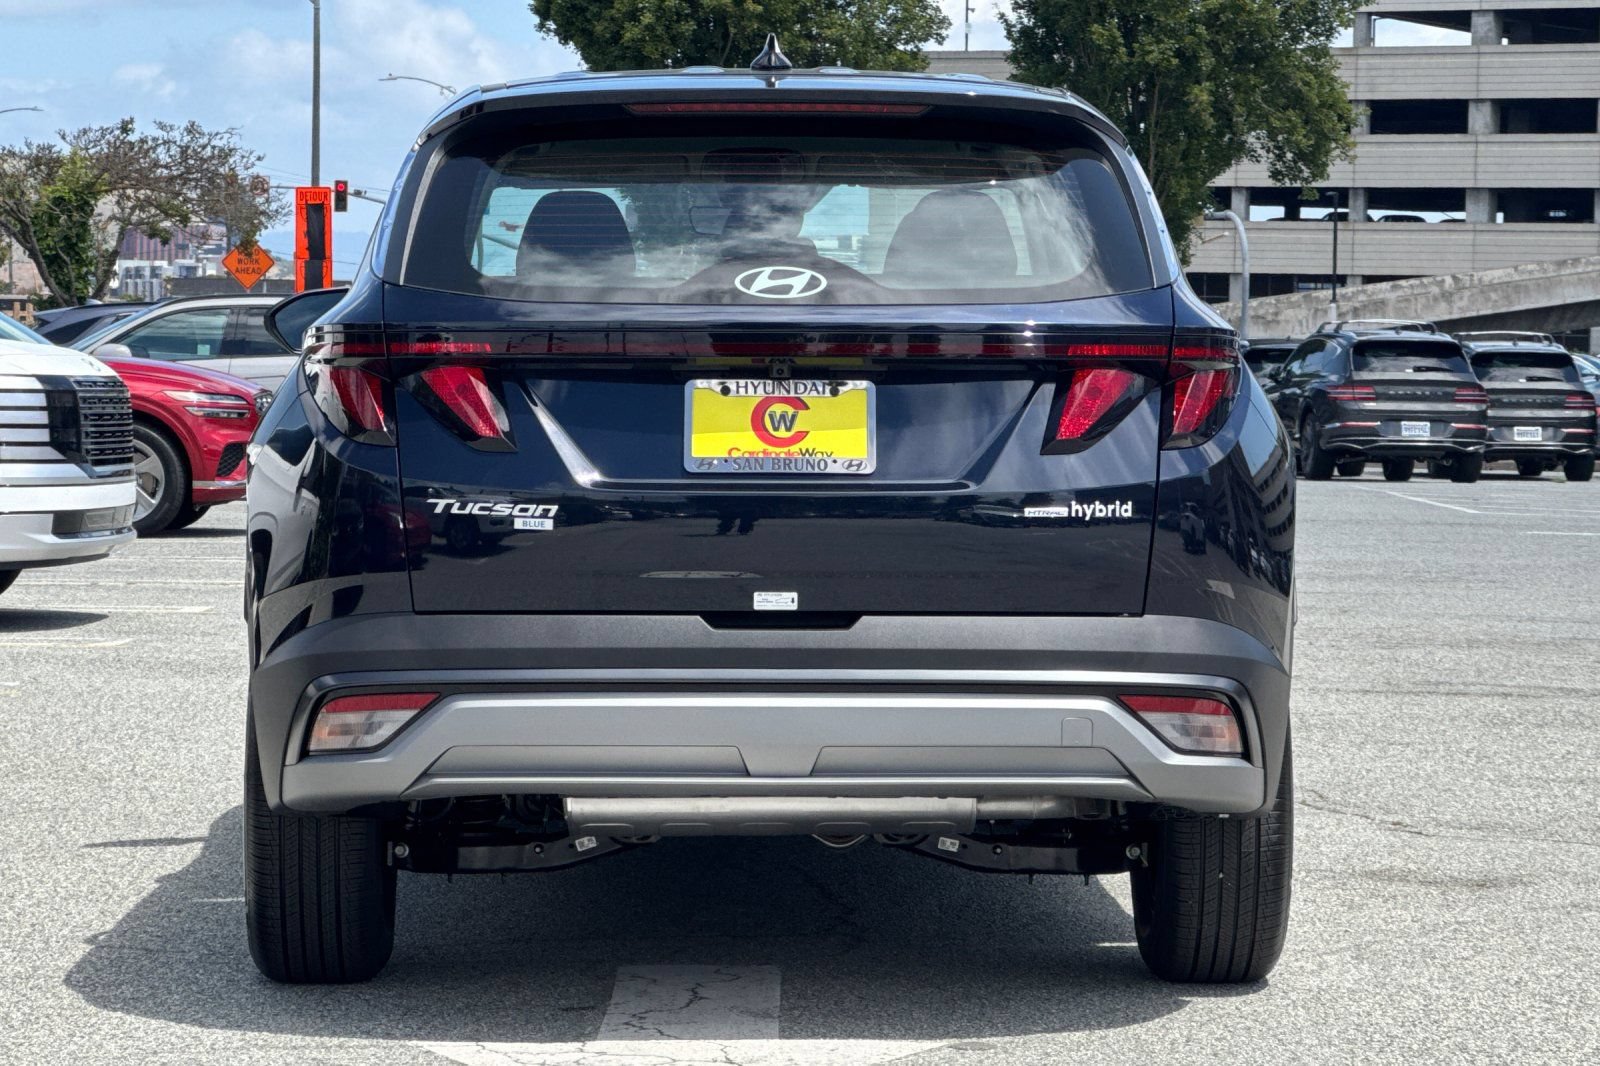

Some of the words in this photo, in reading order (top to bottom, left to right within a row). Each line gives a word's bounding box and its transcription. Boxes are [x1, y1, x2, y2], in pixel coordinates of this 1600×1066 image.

[300, 191, 328, 201] DETOUR
[735, 381, 826, 395] HYUNDAI
[732, 458, 765, 472] SAN
[771, 458, 829, 472] BRUNO
[1071, 500, 1133, 521] hybrid
[522, 520, 546, 528] BLUE
